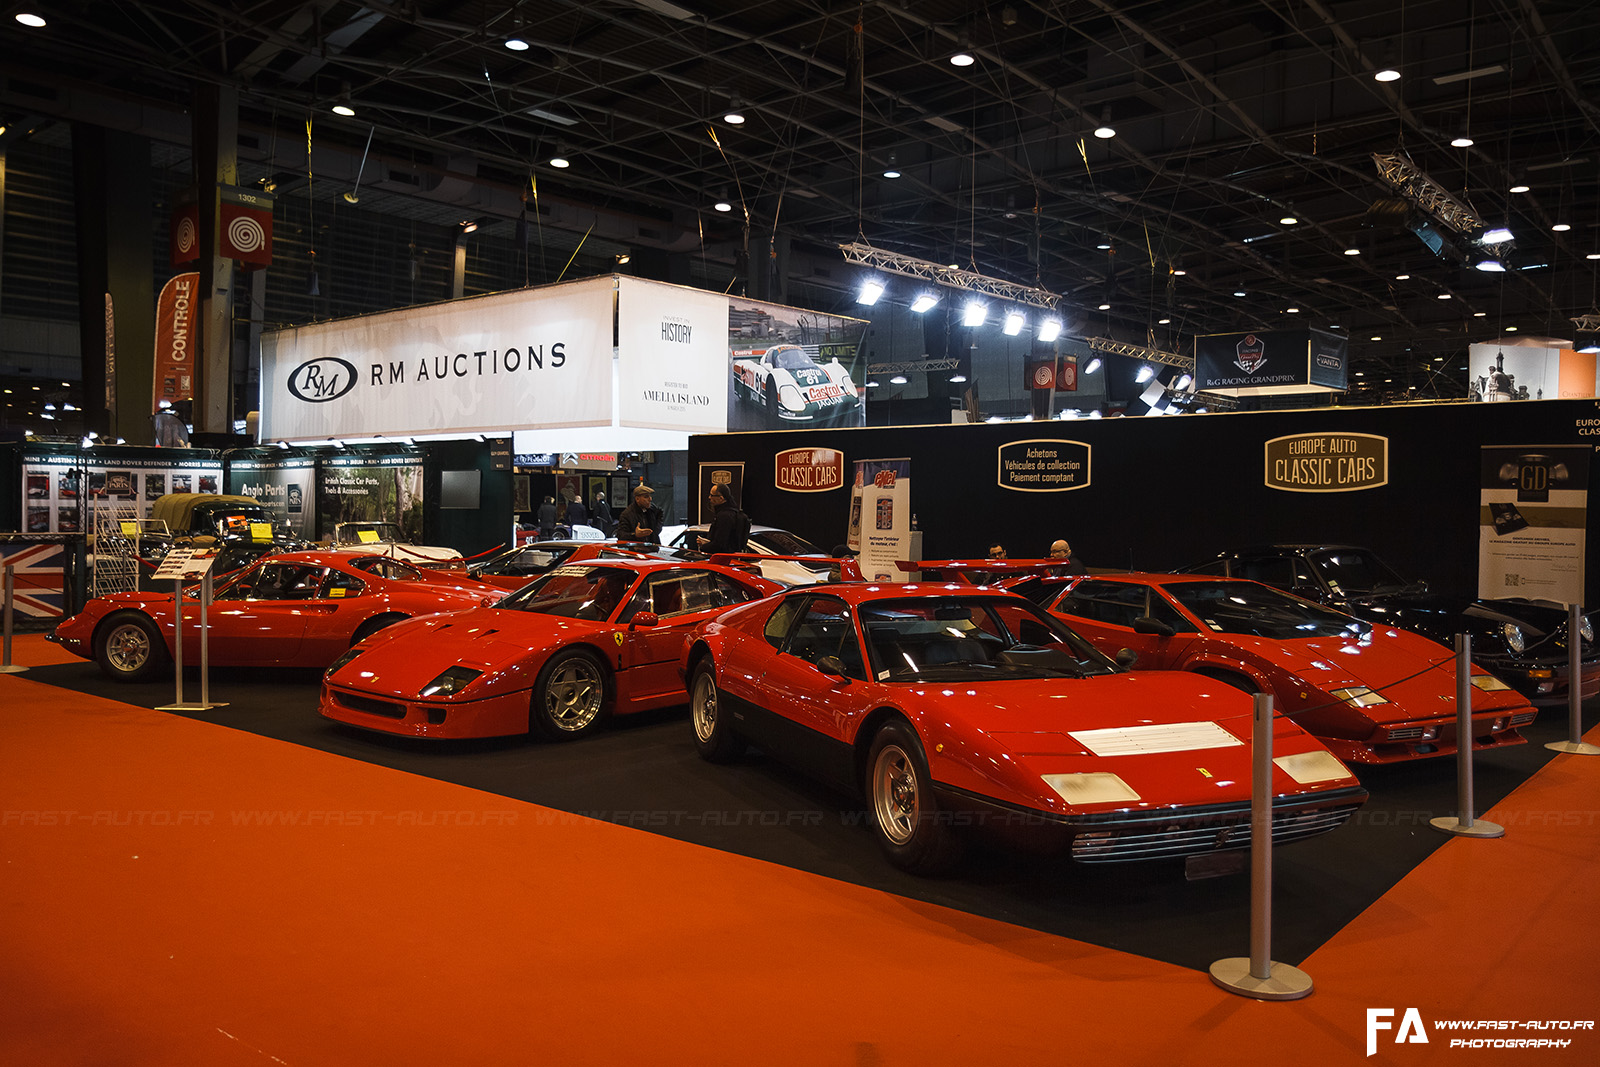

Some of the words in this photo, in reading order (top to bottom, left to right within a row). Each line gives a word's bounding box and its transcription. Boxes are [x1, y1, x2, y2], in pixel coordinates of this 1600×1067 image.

[238, 193, 257, 204] 1302
[172, 280, 190, 362] CONTROLE
[663, 315, 682, 323] INVEST
[661, 321, 692, 344] HISTORY
[371, 360, 405, 386] RM
[417, 342, 567, 383] AUCTIONS
[1251, 375, 1295, 384] GRANDPRIX
[642, 389, 676, 403] AMELIA
[678, 393, 710, 406] ISLAND
[809, 384, 841, 399] Castrol
[1026, 448, 1057, 459] Achetons
[1289, 439, 1325, 455] EUROPE
[1329, 438, 1357, 454] AUTO
[789, 452, 810, 465] EUROPE
[1005, 459, 1035, 470] Véhicules
[1036, 460, 1046, 470] de
[1047, 460, 1080, 470] collection
[781, 466, 813, 486] CLASSIC
[816, 465, 837, 485] CARS
[1010, 471, 1040, 482] Paiement
[1041, 472, 1074, 484] comptant
[1275, 459, 1331, 485] CLASSIC
[1337, 457, 1375, 484] CARS
[1521, 465, 1547, 491] GD
[242, 483, 263, 499] Anglo
[265, 483, 285, 496] Parts
